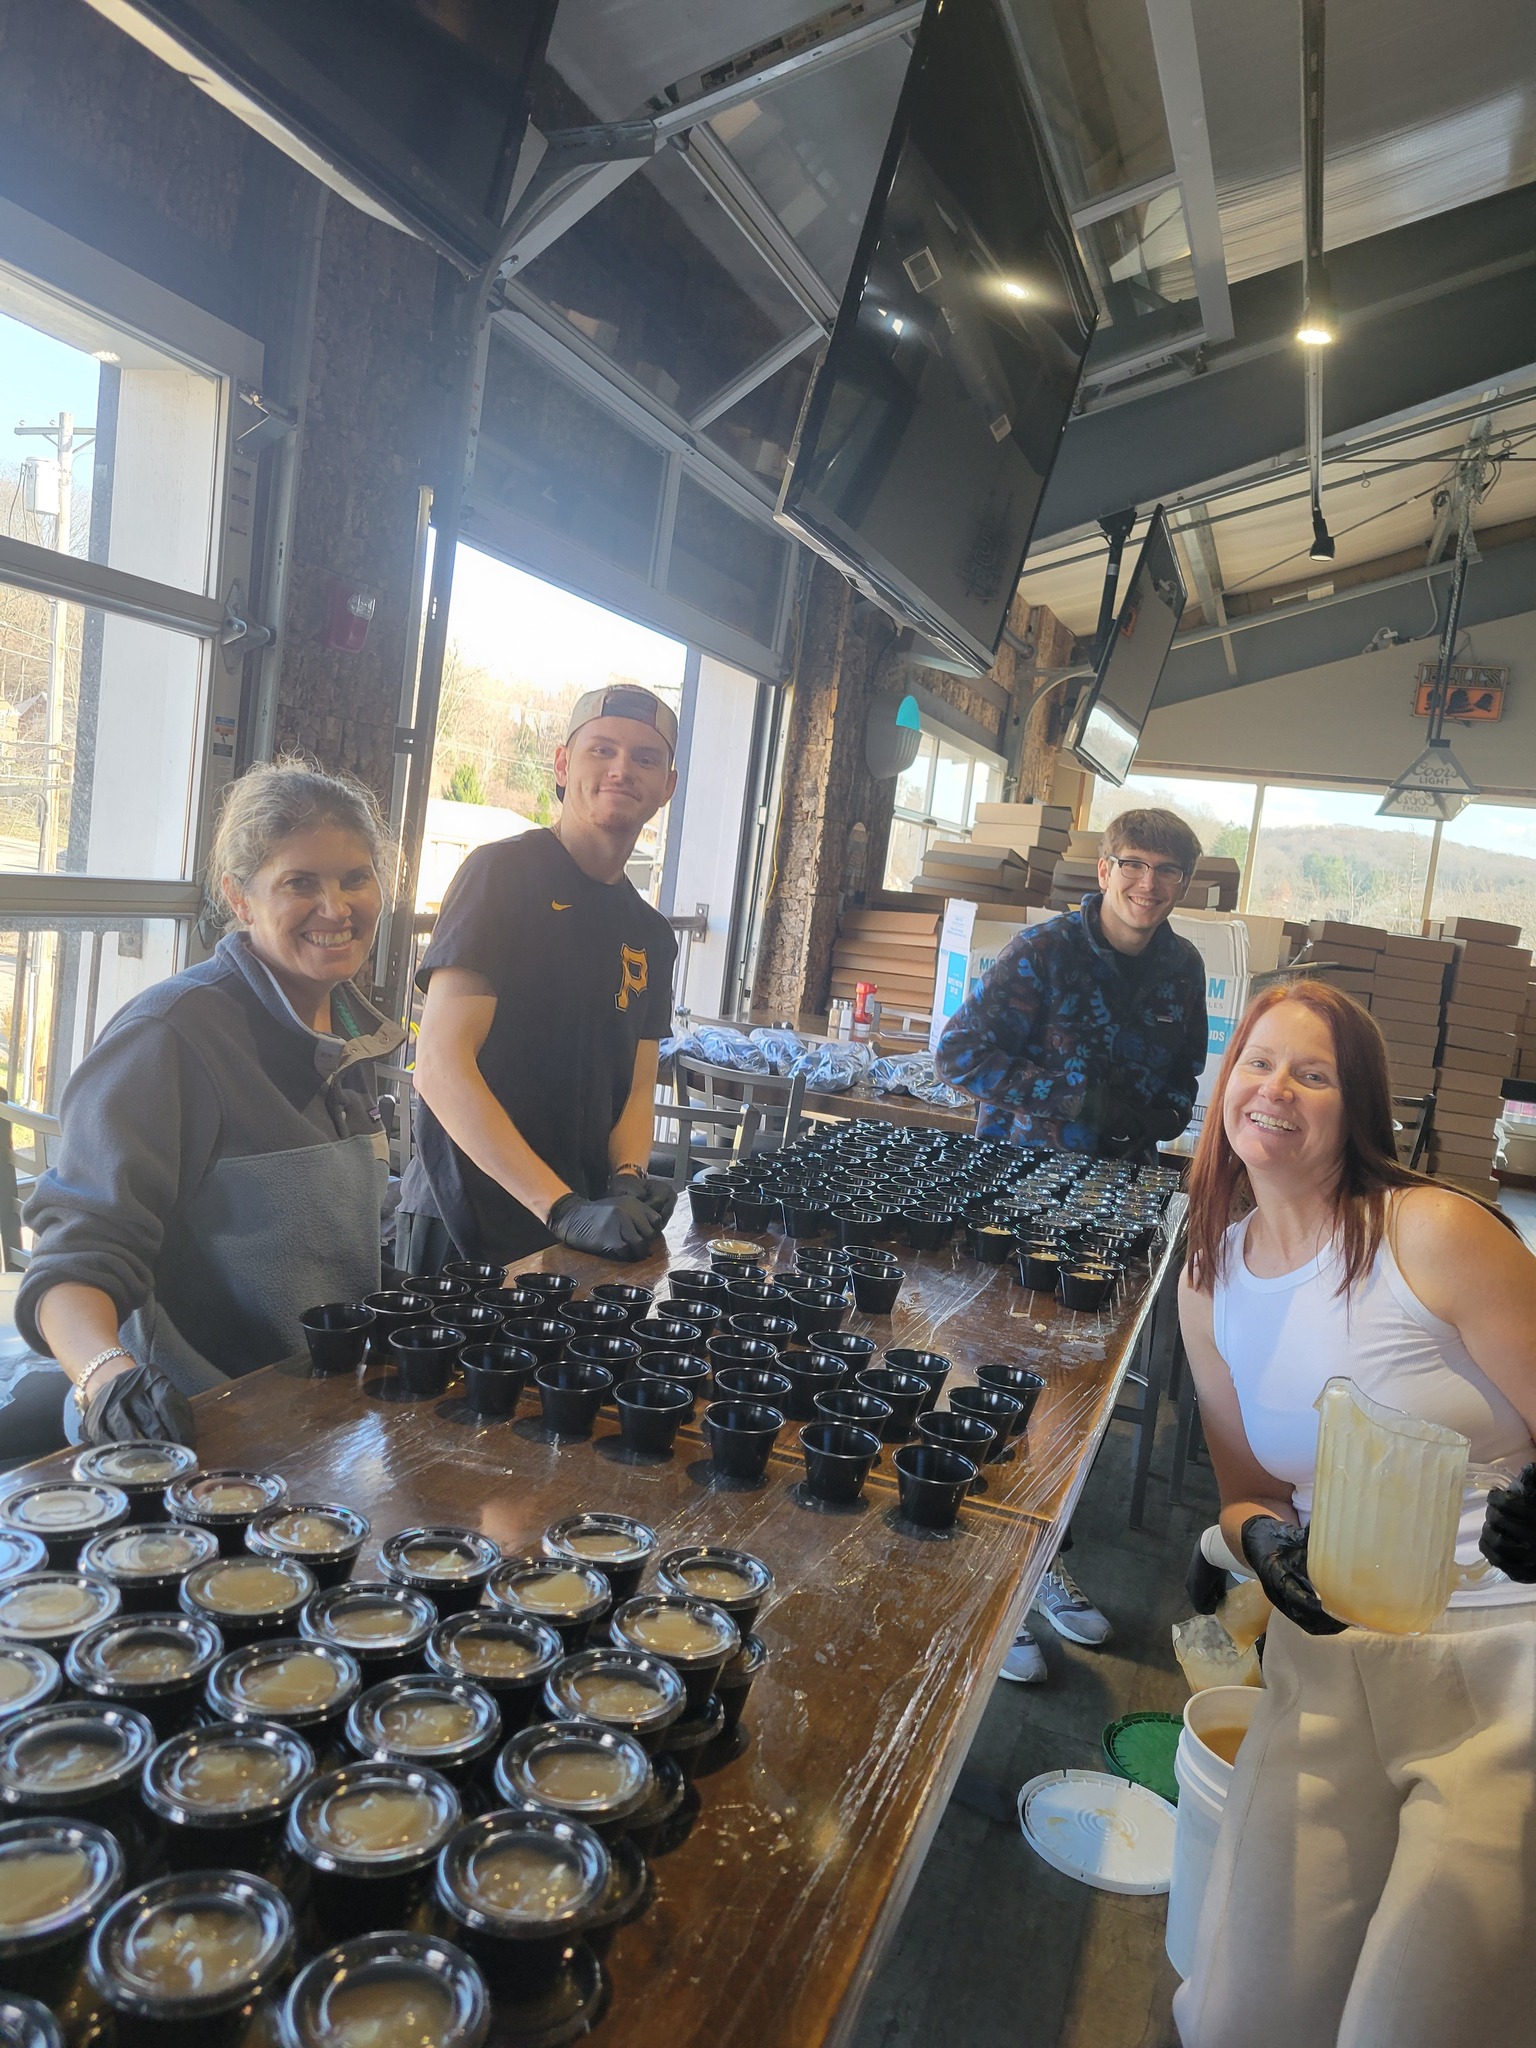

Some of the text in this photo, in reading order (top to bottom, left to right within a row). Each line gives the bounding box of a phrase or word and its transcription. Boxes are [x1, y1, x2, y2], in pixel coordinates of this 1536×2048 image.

[1412, 761, 1459, 778] Coors
[1419, 777, 1450, 786] LIGHT
[614, 942, 649, 1012] P
[1208, 1002, 1224, 1010] LES
[1208, 1029, 1226, 1042] IDS
